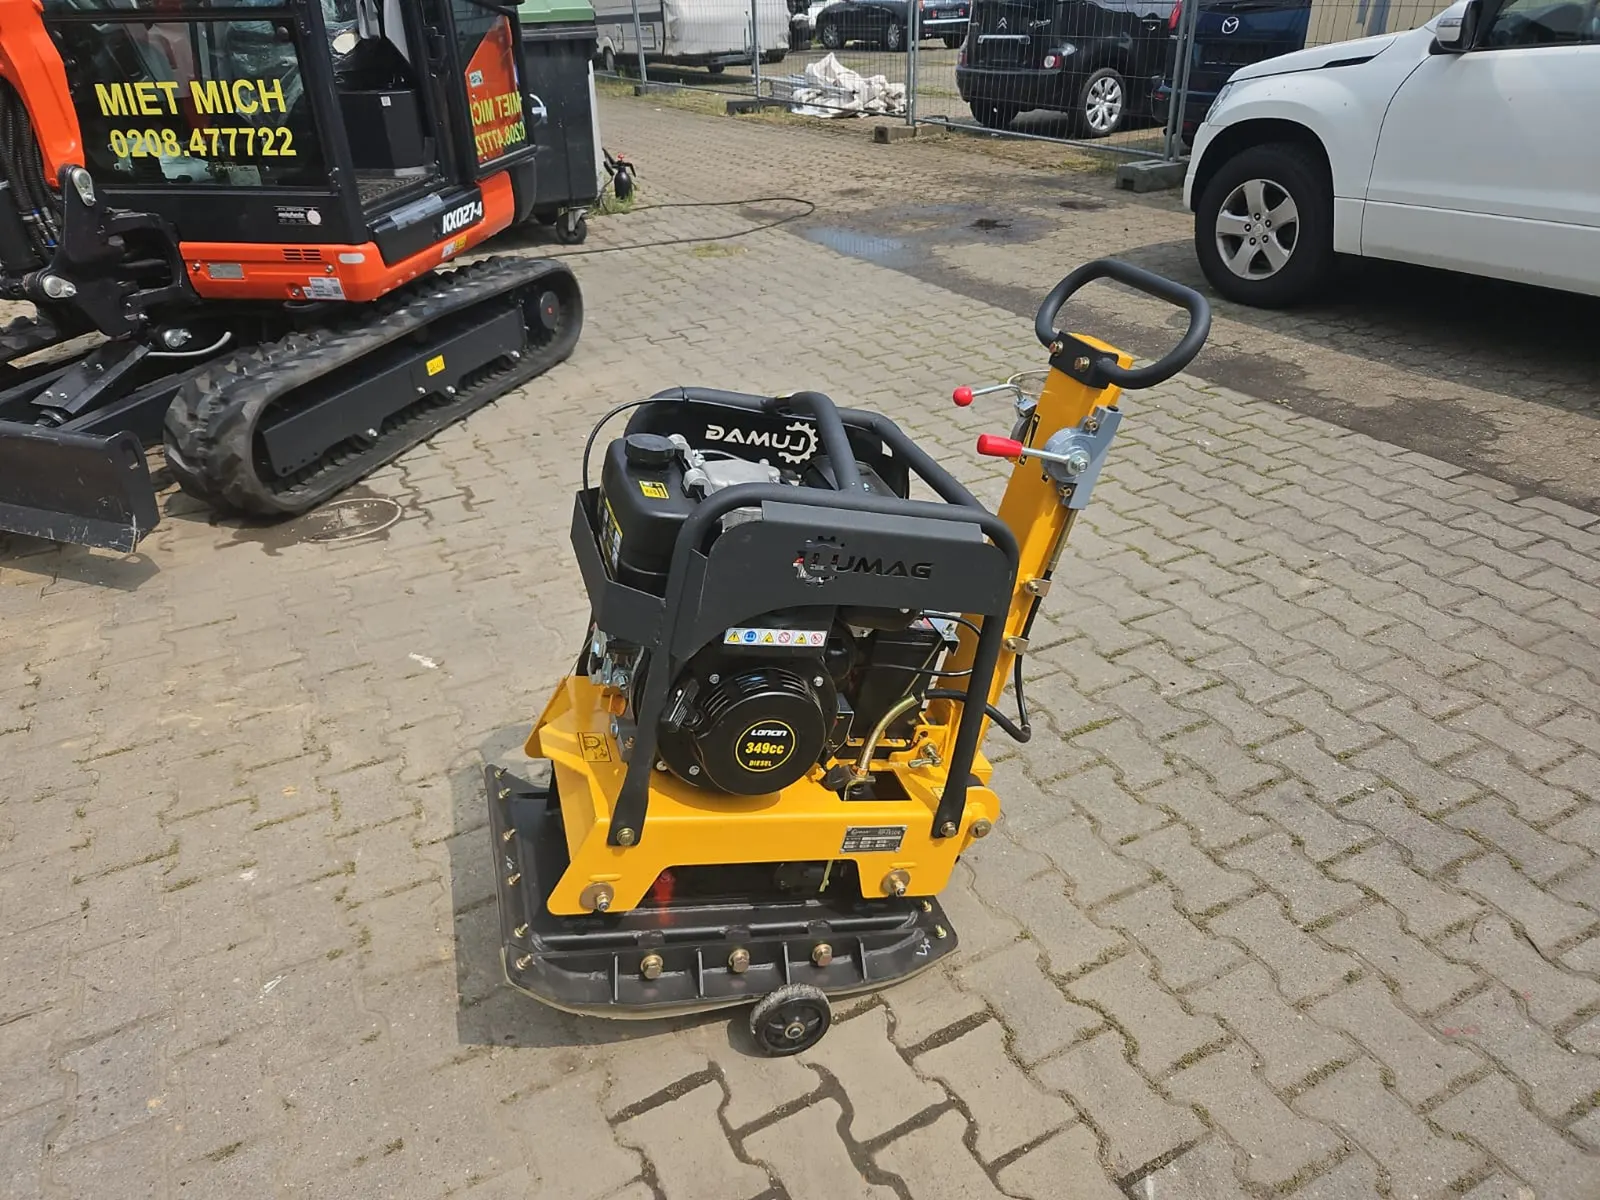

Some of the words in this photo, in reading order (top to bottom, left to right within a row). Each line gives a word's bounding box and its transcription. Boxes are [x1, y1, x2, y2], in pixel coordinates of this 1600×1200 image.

[94, 81, 179, 116] MIET
[189, 78, 287, 115] MICH
[109, 126, 297, 158] 0208.477722
[442, 201, 483, 234] KX027-4
[805, 550, 935, 581] LUMAG
[745, 741, 785, 754] 349cc
